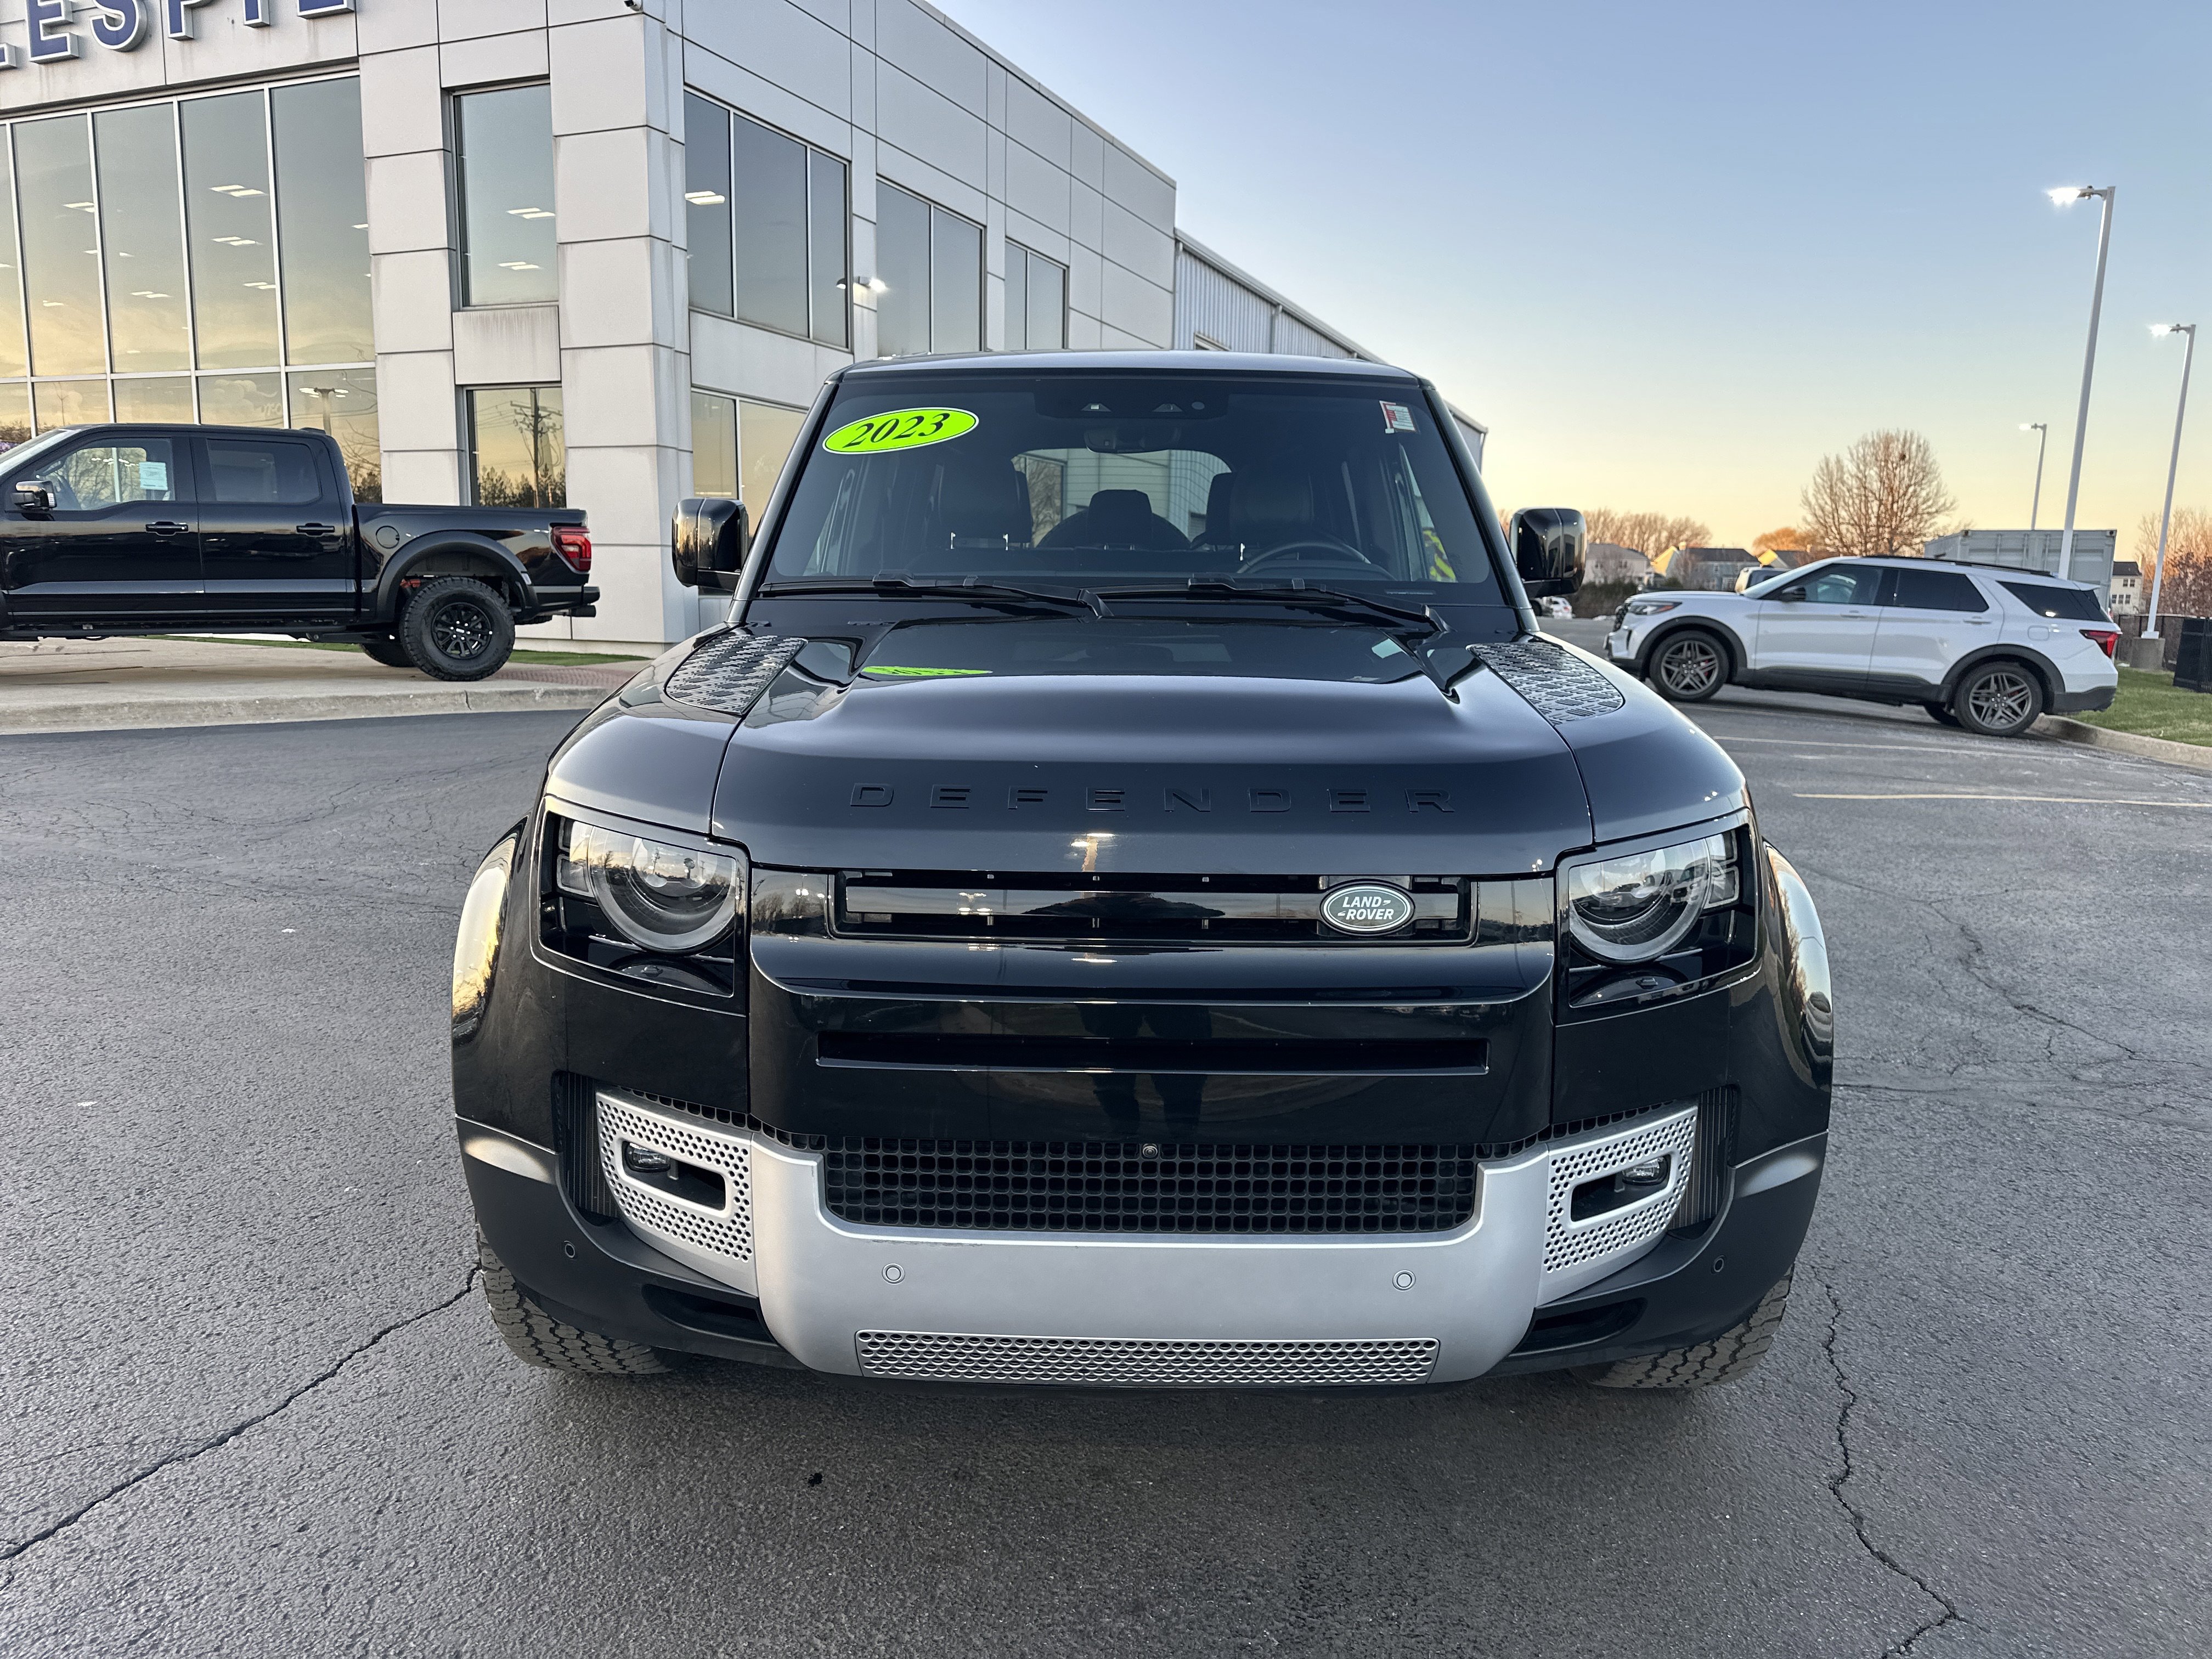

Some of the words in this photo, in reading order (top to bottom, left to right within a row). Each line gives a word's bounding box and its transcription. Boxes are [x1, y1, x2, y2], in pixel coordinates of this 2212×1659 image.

[842, 413, 950, 448] 2023
[850, 782, 1455, 813] DEFENDER
[1342, 896, 1382, 907] LAND
[1346, 909, 1394, 920] ROVER
